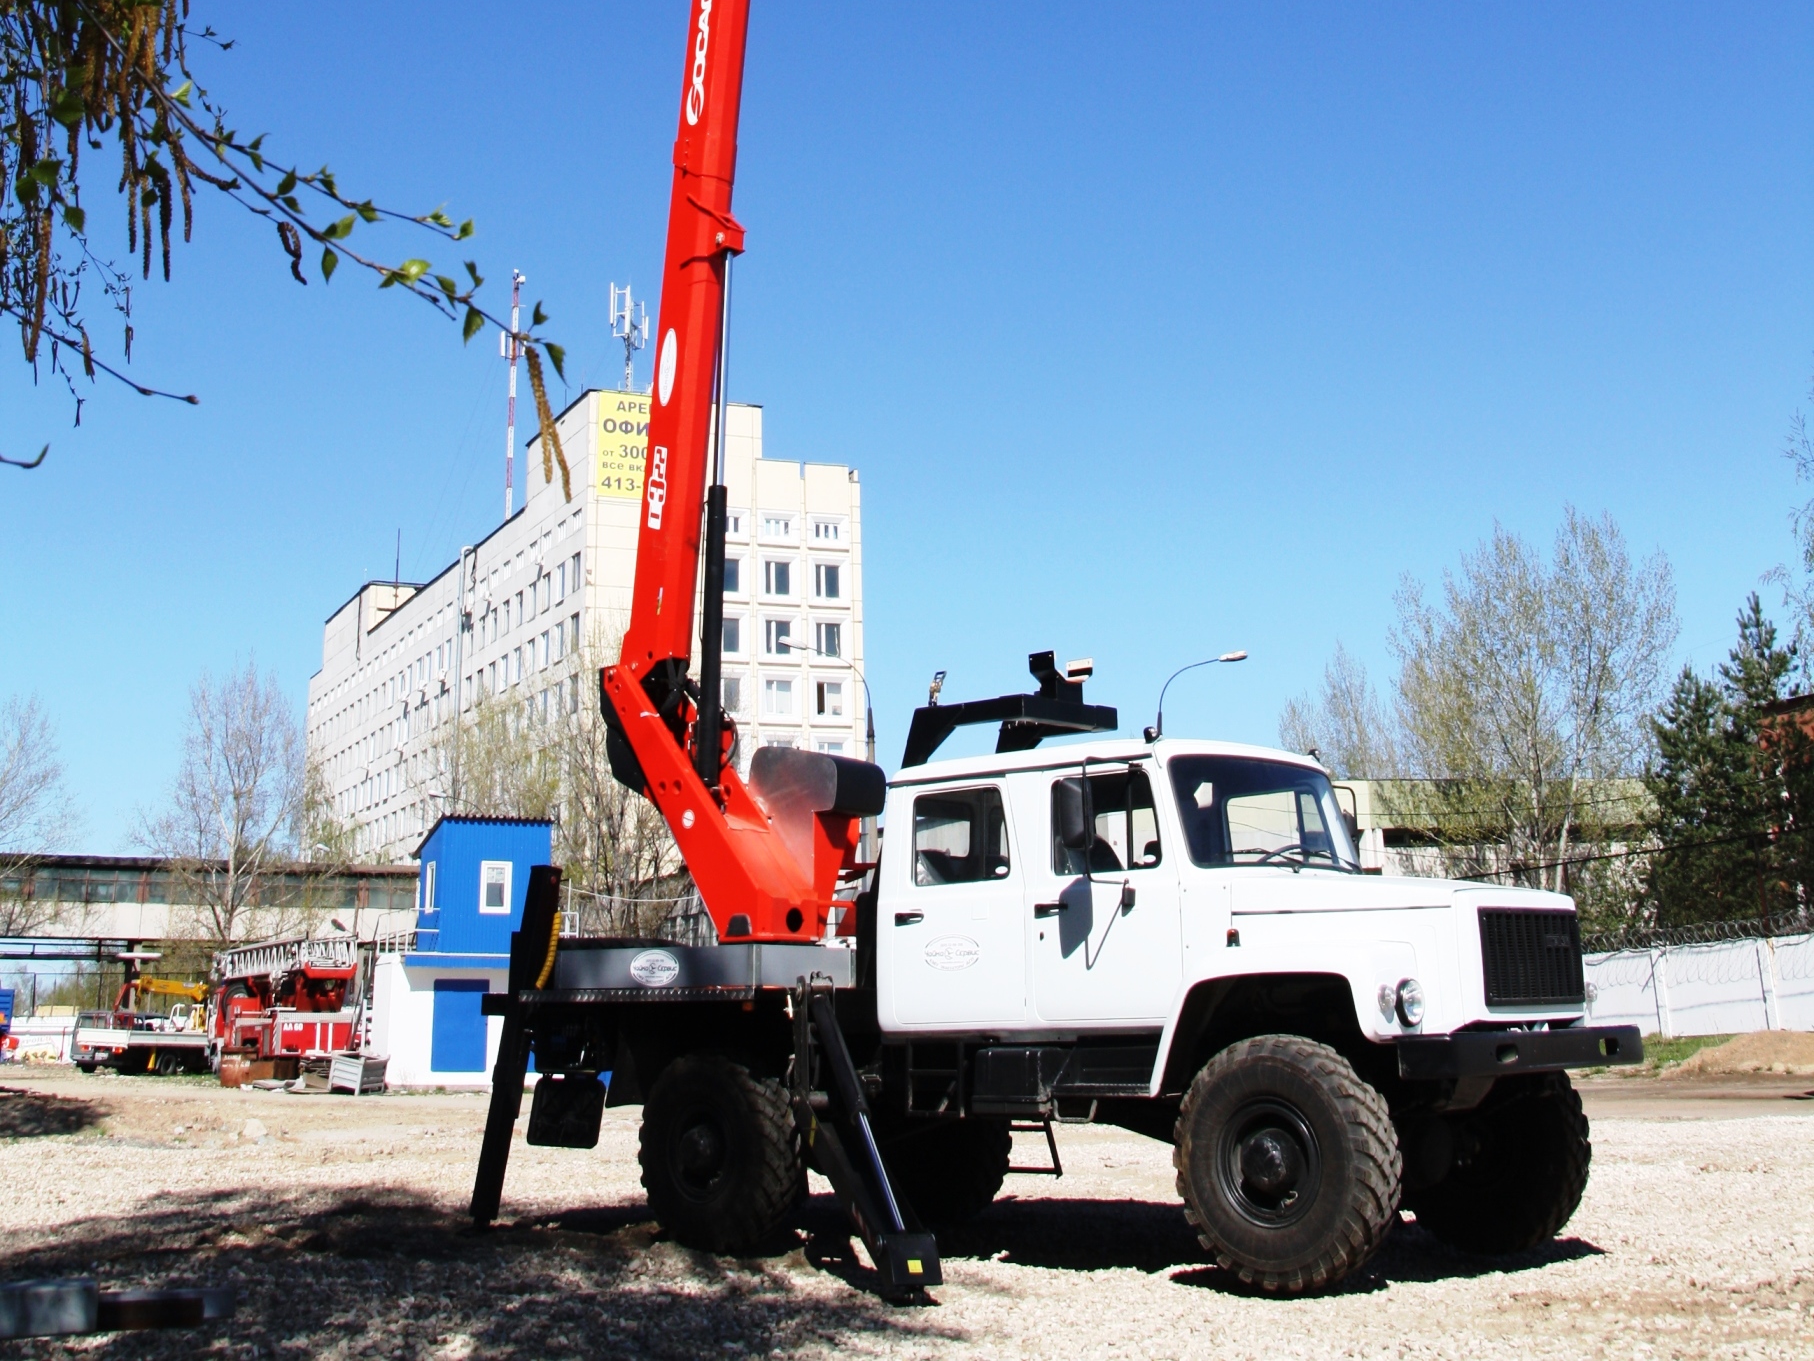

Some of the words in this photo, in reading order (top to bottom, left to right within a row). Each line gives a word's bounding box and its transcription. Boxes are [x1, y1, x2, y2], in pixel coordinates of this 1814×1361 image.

[616, 400, 652, 415] АРЕ
[602, 461, 624, 471] все
[629, 464, 646, 473] вк
[601, 475, 644, 492] 413-
[294, 1023, 303, 1031] 60
